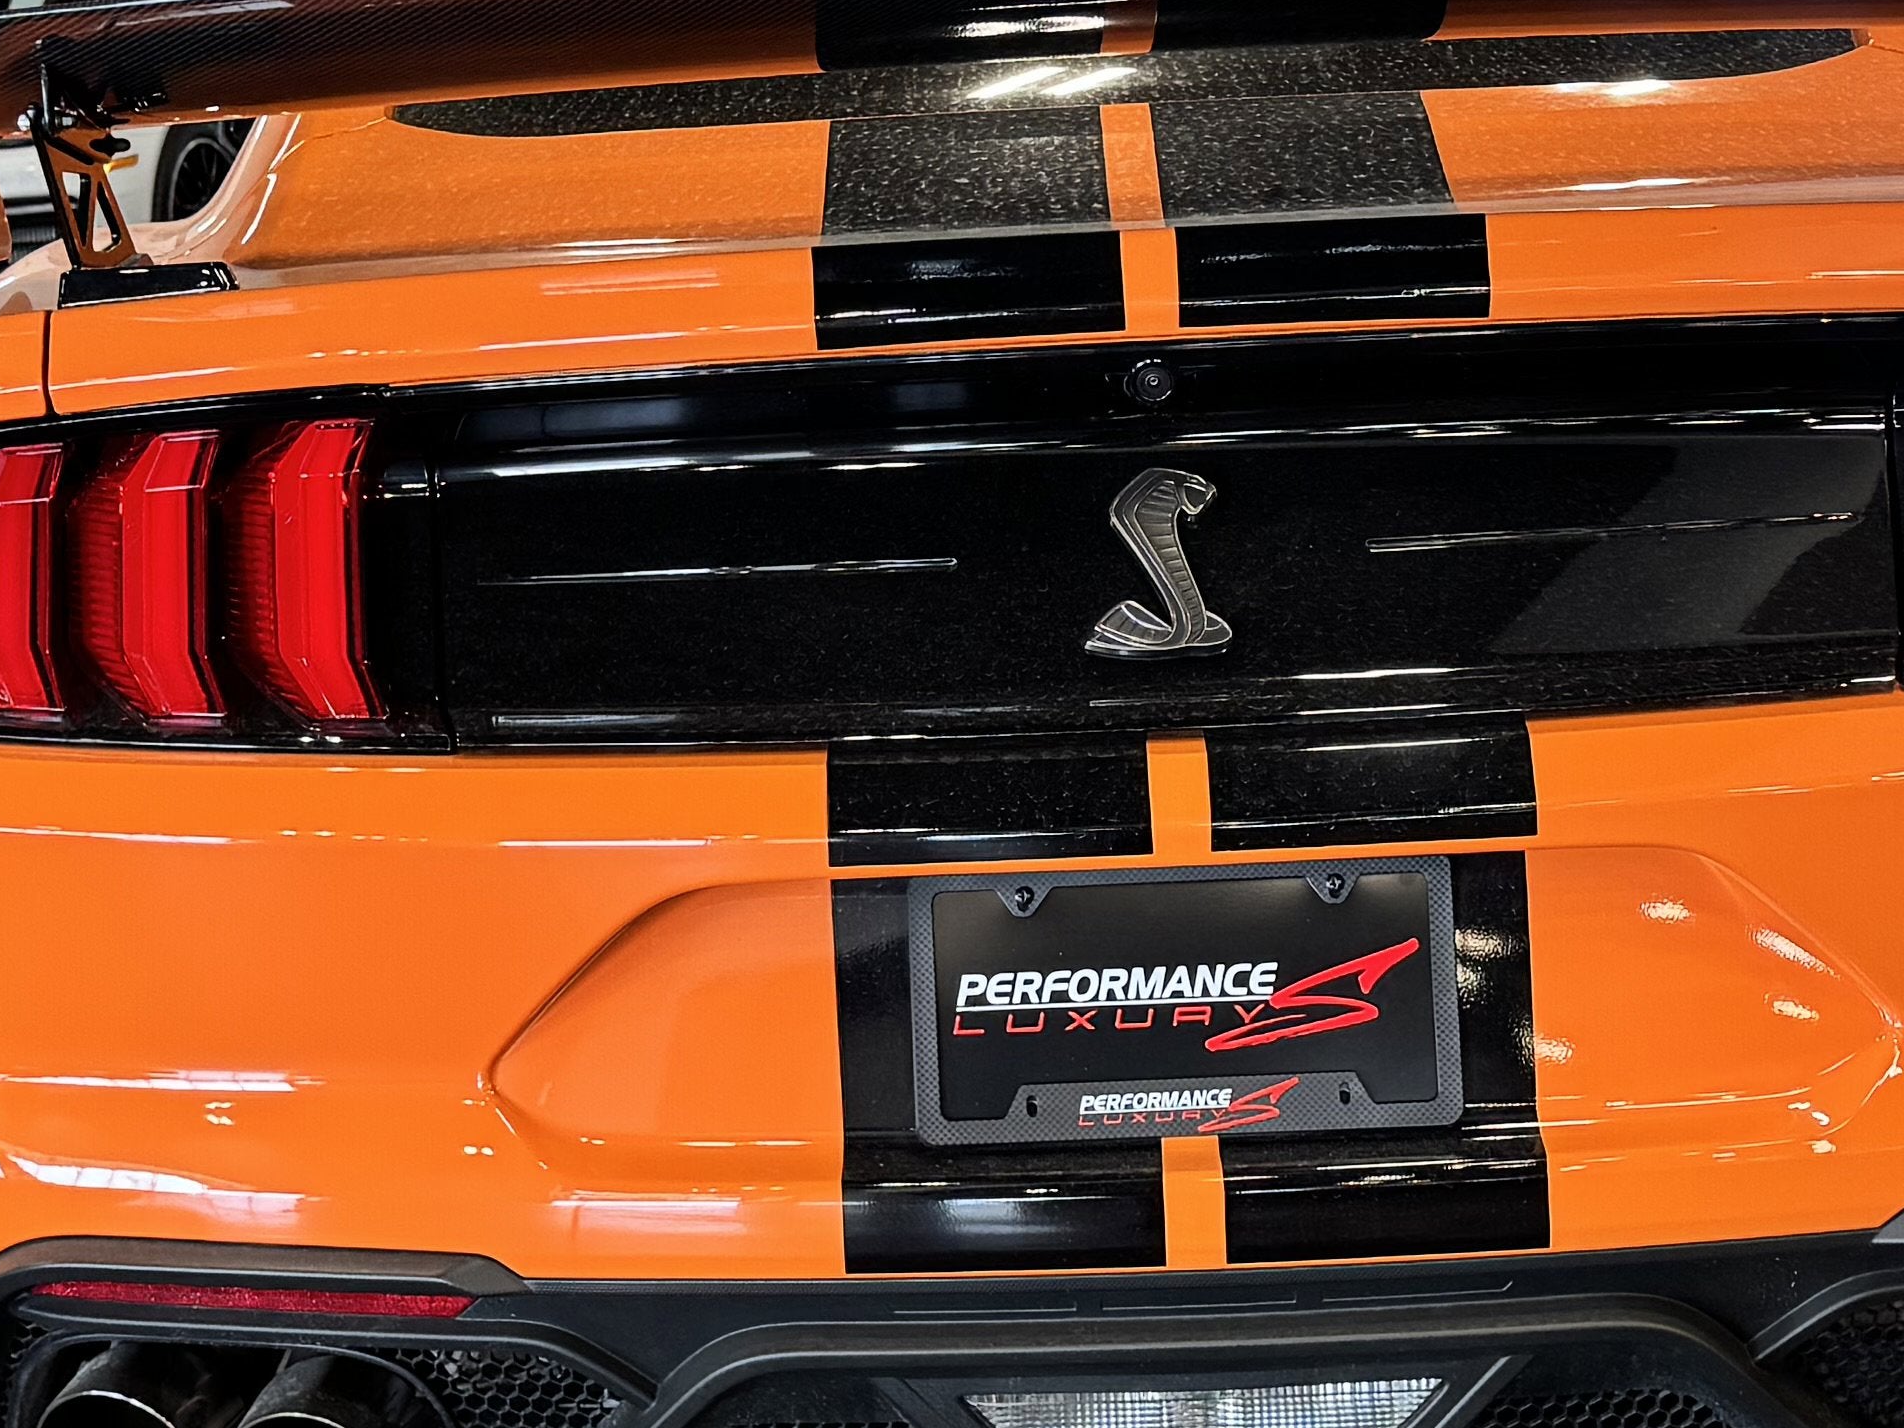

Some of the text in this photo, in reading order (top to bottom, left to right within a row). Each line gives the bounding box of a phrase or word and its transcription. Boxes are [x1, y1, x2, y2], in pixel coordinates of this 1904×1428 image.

[956, 961, 1279, 1007] PERFORMANCE
[953, 1003, 1266, 1036] LUXURY
[1079, 1088, 1233, 1112] PERFORMANCE
[1078, 1109, 1227, 1126] LUXURY
